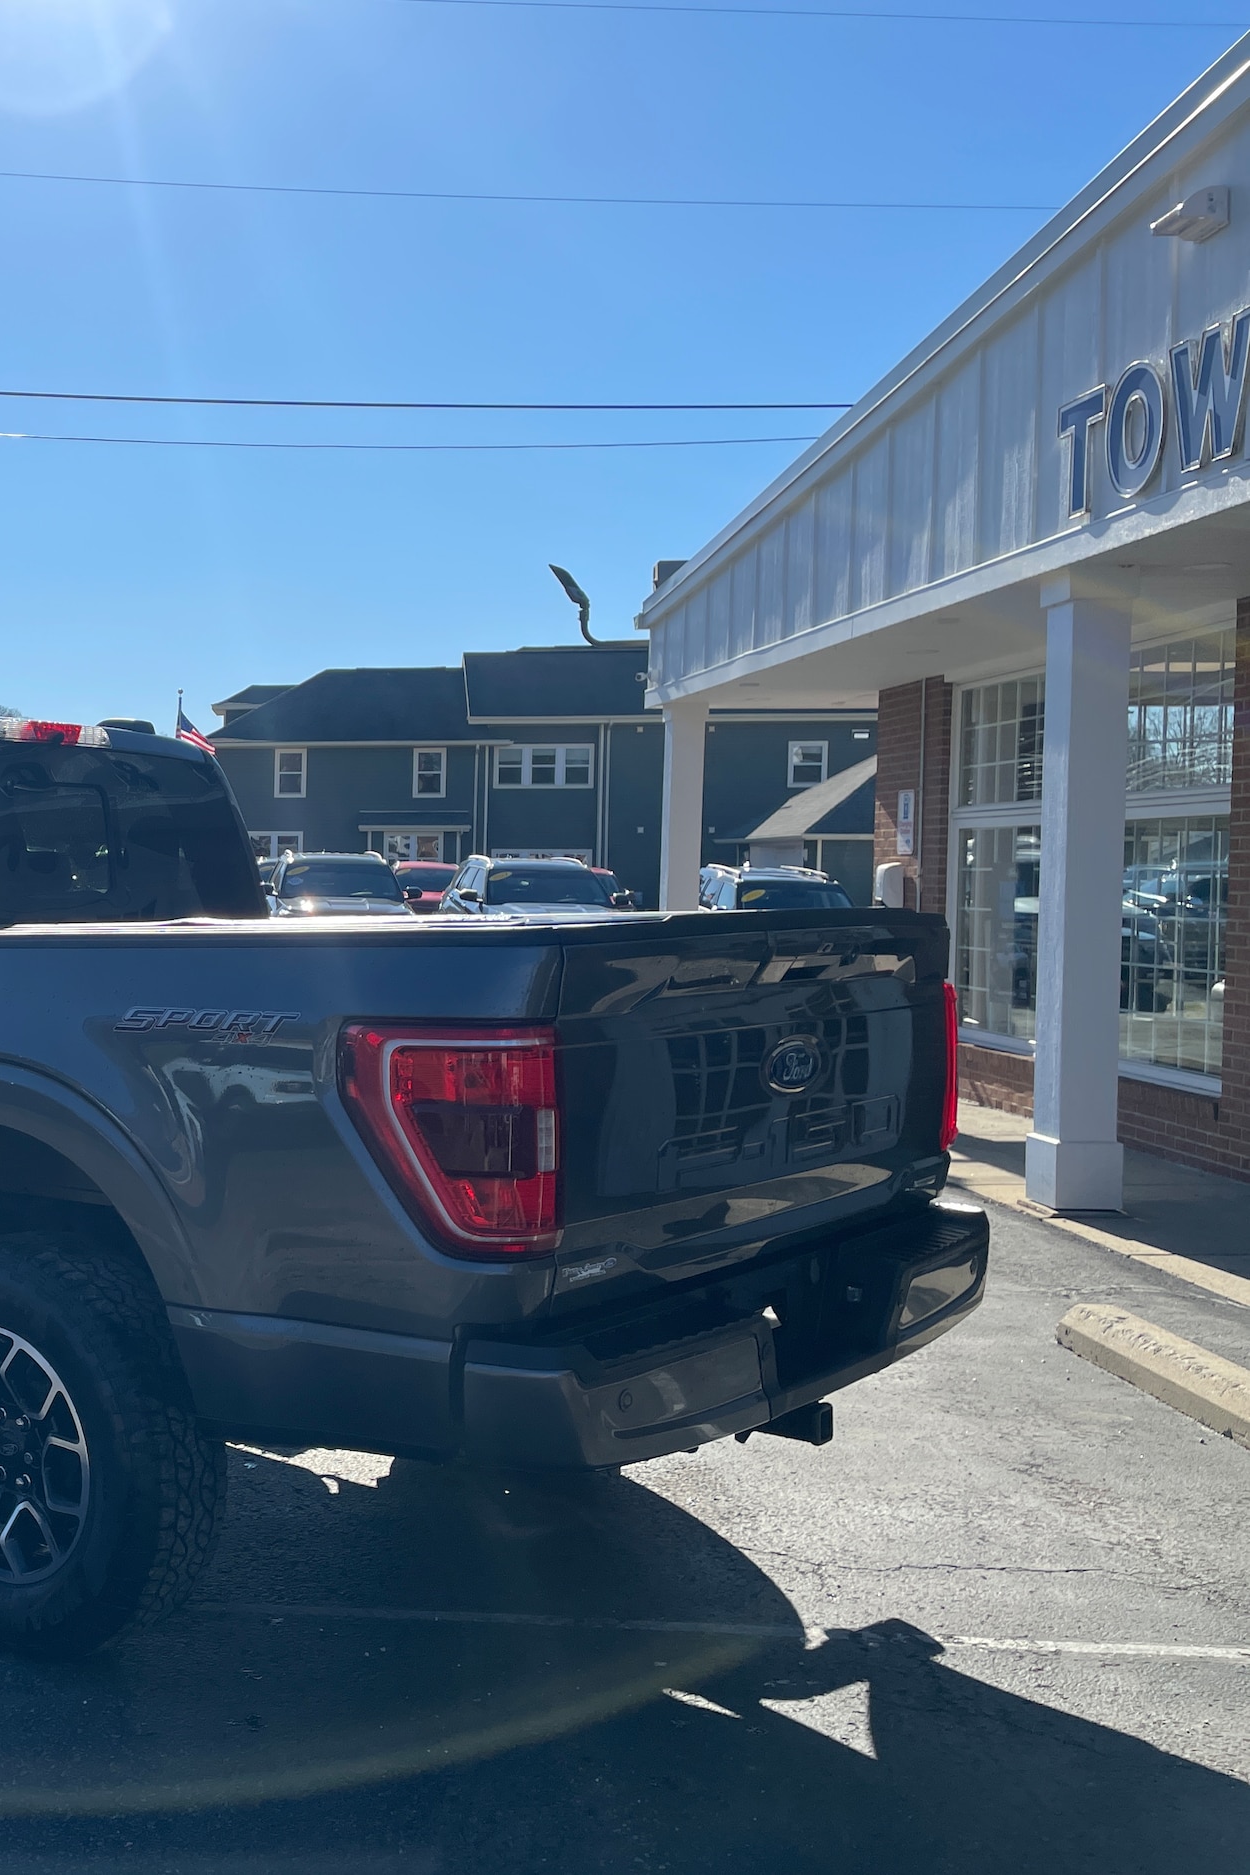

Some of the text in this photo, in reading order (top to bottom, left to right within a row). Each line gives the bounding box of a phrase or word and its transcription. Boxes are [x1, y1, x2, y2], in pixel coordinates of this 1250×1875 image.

[1057, 306, 1250, 520] TOW
[113, 1006, 300, 1033] SPORT
[783, 1053, 813, 1080] Ford
[657, 1094, 900, 1194] F-150
